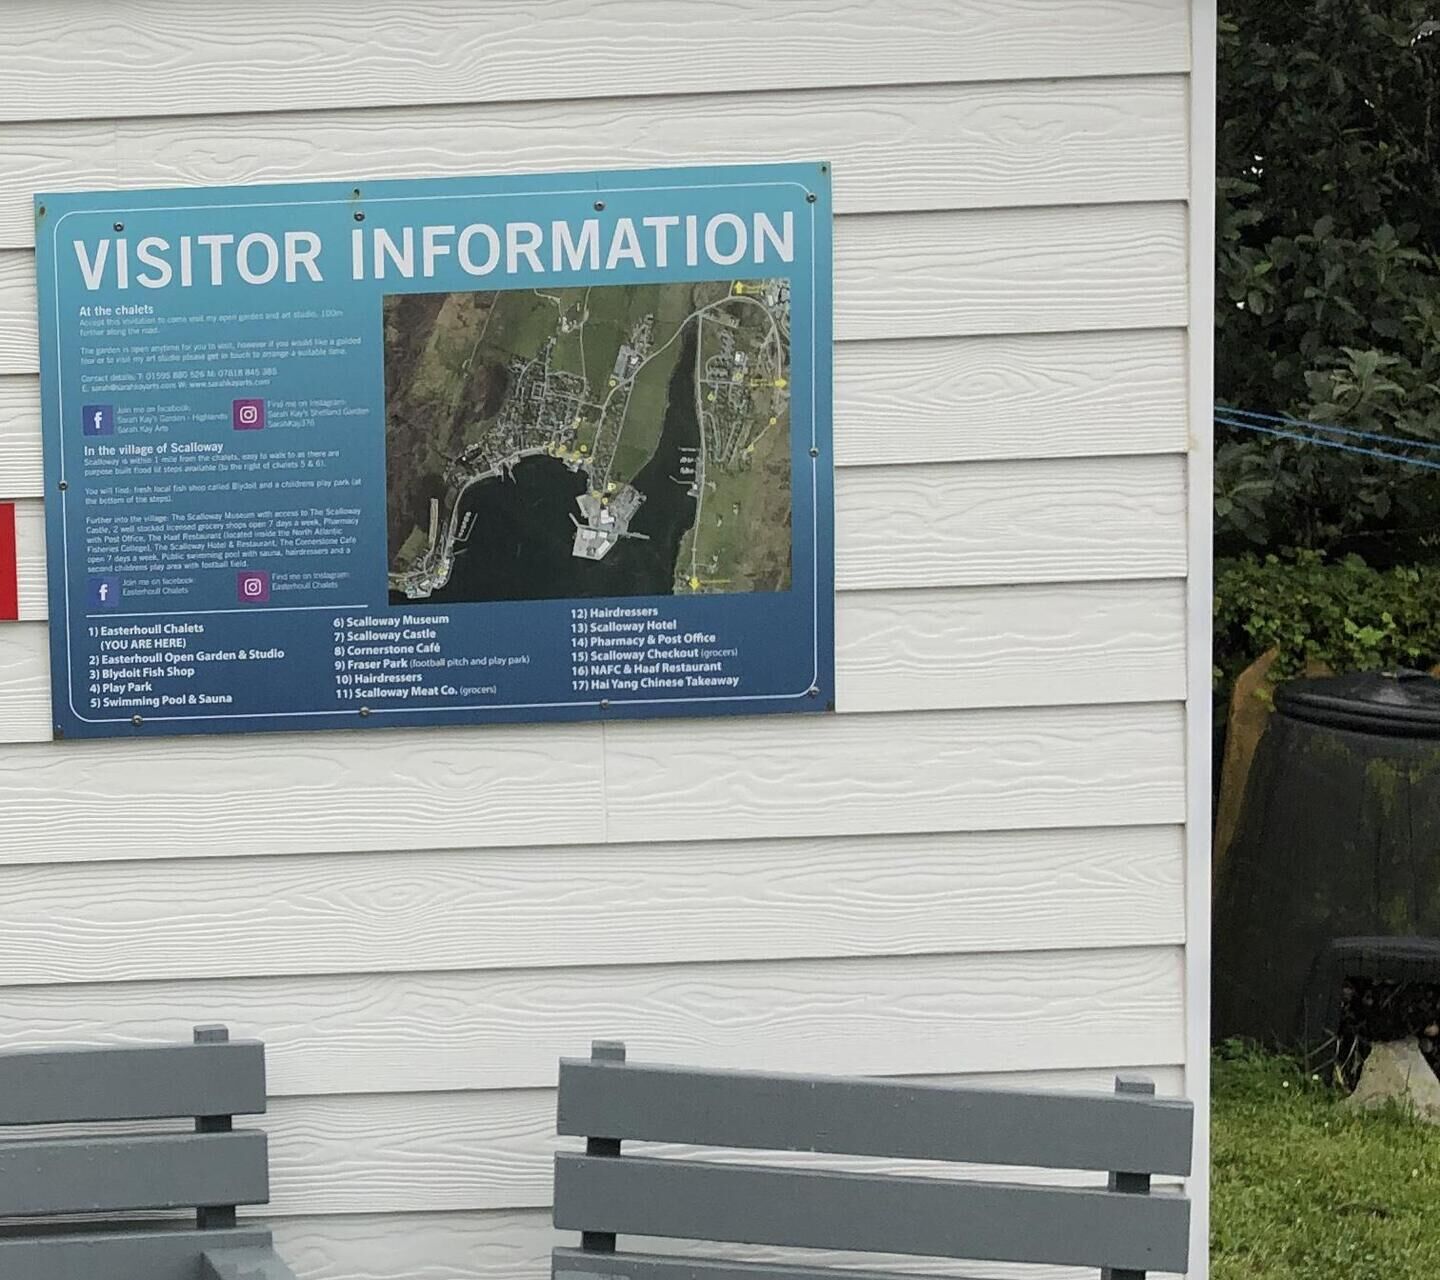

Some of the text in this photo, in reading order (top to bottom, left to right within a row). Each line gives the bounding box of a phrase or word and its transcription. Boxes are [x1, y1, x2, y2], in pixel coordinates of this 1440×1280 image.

[74, 210, 794, 292] VISITOR INFORMATION
[79, 303, 153, 316] At the chalets
[93, 411, 103, 429] f
[83, 440, 223, 457] In the village of Scalloway
[99, 583, 108, 602] f
[333, 613, 449, 630] 6) Scalloway Museum
[571, 606, 658, 621] 12) Hairdressers
[87, 622, 203, 639] 1) Easterhoull Chalets
[572, 619, 677, 635] 13) Scalloway Hotel
[334, 628, 436, 644] 7) Scalloway Castle
[572, 632, 715, 650] 14) Pharmacy & Post Office
[100, 637, 186, 653] (YOU ARE HERE)
[334, 642, 440, 658] 8) Cornerstone Café
[89, 648, 284, 667] 2) Easterhoull Open Garden & Studio
[334, 654, 530, 673] 9) Fraser Park (football pitch and play park)
[572, 647, 738, 664] 15) Scalloway Checkout (grocers)
[89, 665, 195, 681] 3) Blydoit Fish Shop
[572, 660, 721, 678] 16) NAFC & Haaf Restaurant
[336, 671, 422, 687] 10) Hairdressers
[572, 674, 739, 692] 17) Hai Yang Chinese Takeaway
[90, 681, 152, 695] 4) Play Park
[336, 684, 497, 701] 11) Scalloway Meat Co. (grocers)
[90, 692, 232, 710] 5) Swimming Pool & Sauna
